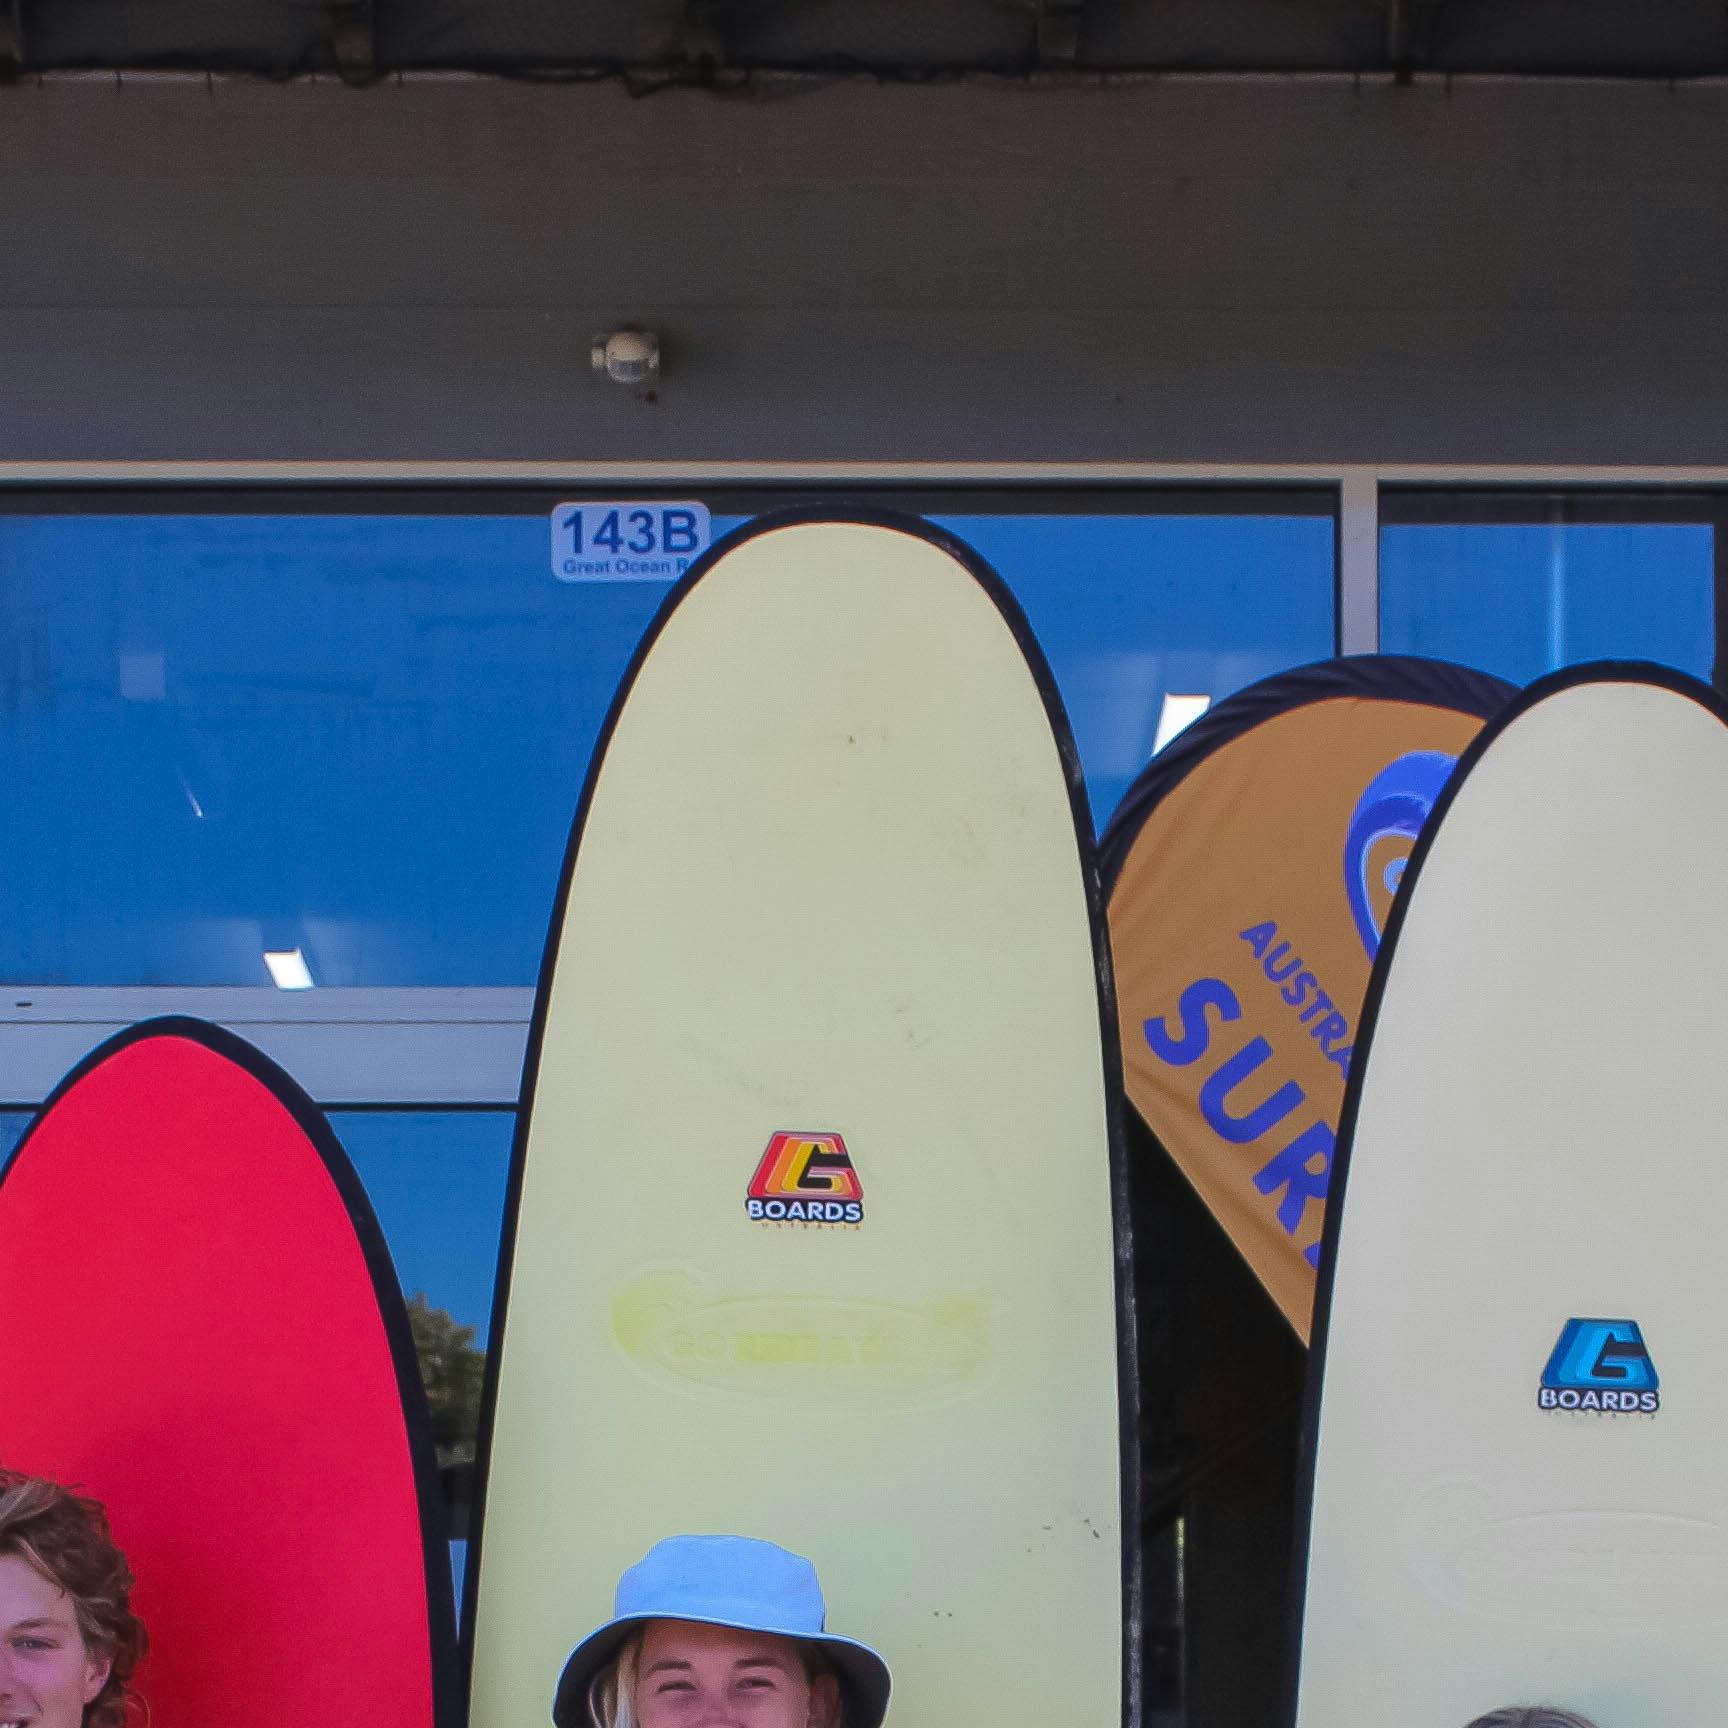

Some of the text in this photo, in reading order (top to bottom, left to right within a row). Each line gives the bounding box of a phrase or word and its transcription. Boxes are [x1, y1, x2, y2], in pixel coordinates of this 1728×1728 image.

[563, 509, 698, 554] 143B
[565, 558, 610, 574] Great
[615, 558, 670, 574] Ocean
[1143, 977, 1337, 1271] SUR
[747, 1199, 862, 1221] BOARDS
[1539, 1389, 1658, 1411] BOARDS
